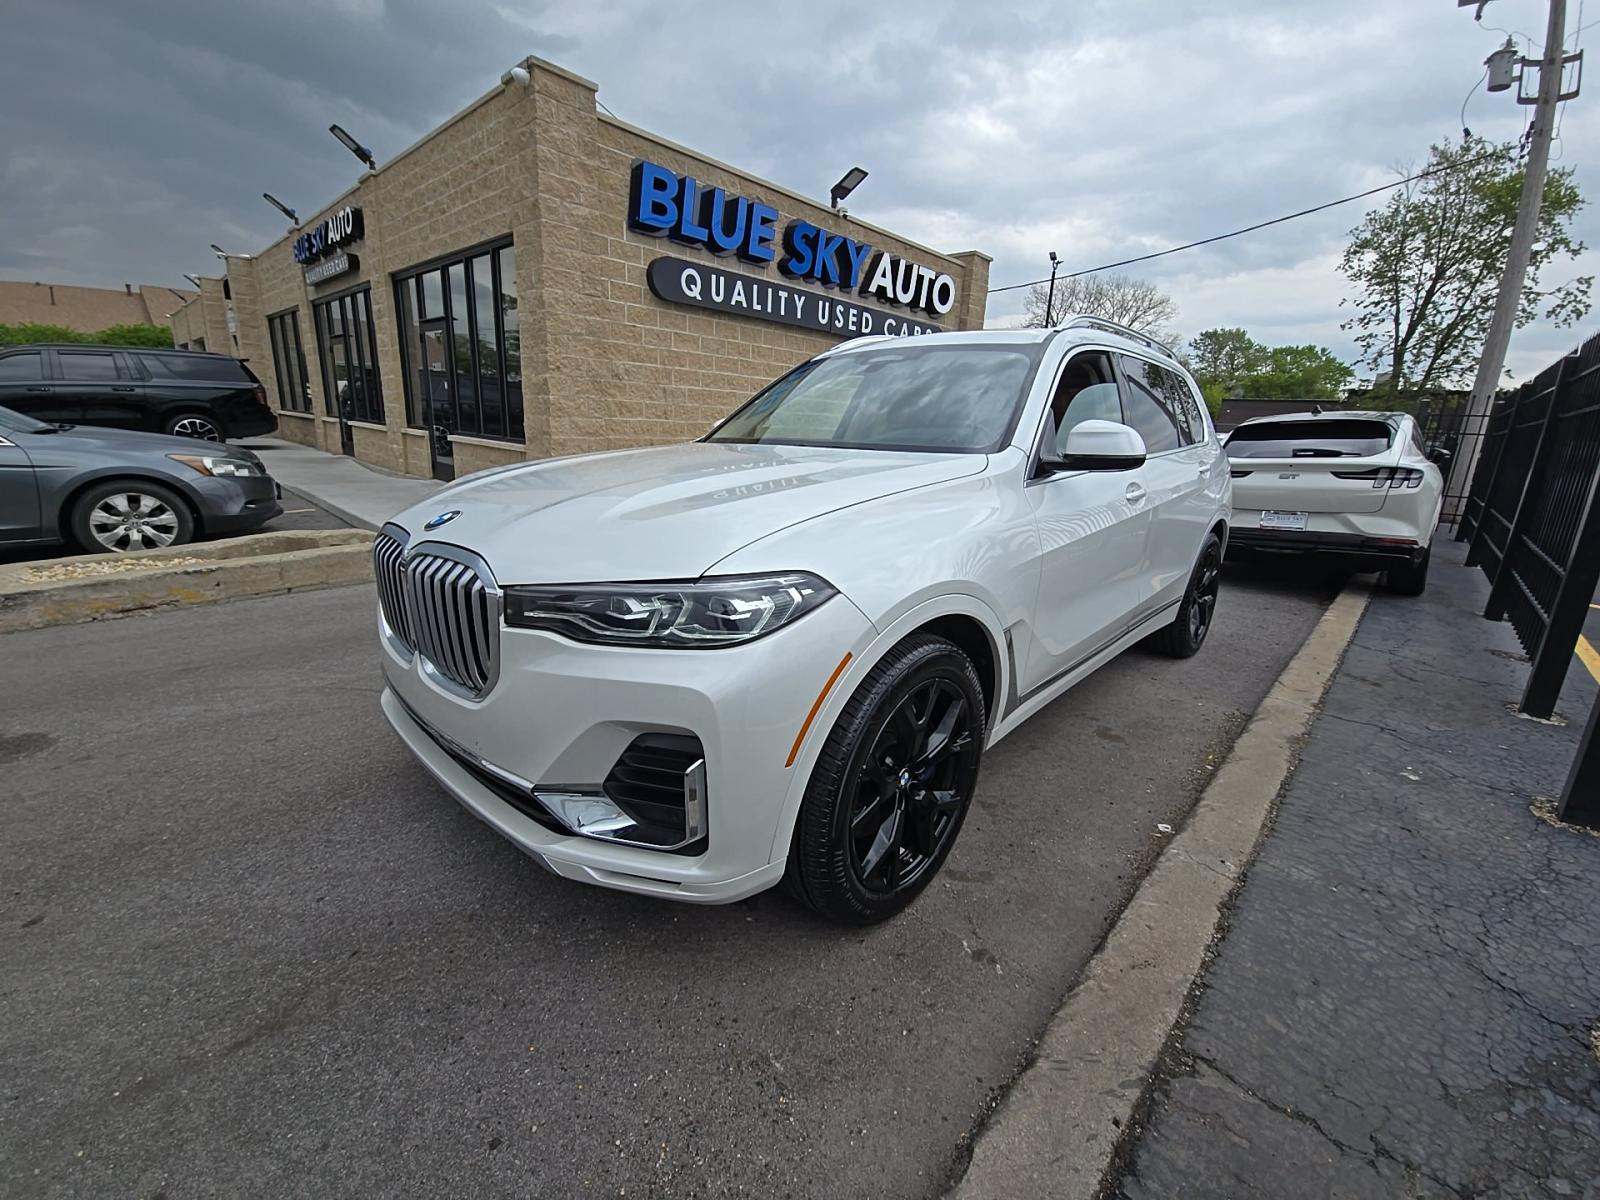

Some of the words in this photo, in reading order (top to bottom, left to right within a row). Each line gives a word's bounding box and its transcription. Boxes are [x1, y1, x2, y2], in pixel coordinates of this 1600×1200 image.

[328, 206, 353, 245] AUTO
[637, 161, 779, 262] BLUE
[787, 220, 871, 288] SKY
[868, 251, 956, 314] AUTO
[680, 268, 806, 319] QUALITY
[818, 301, 873, 334] USED
